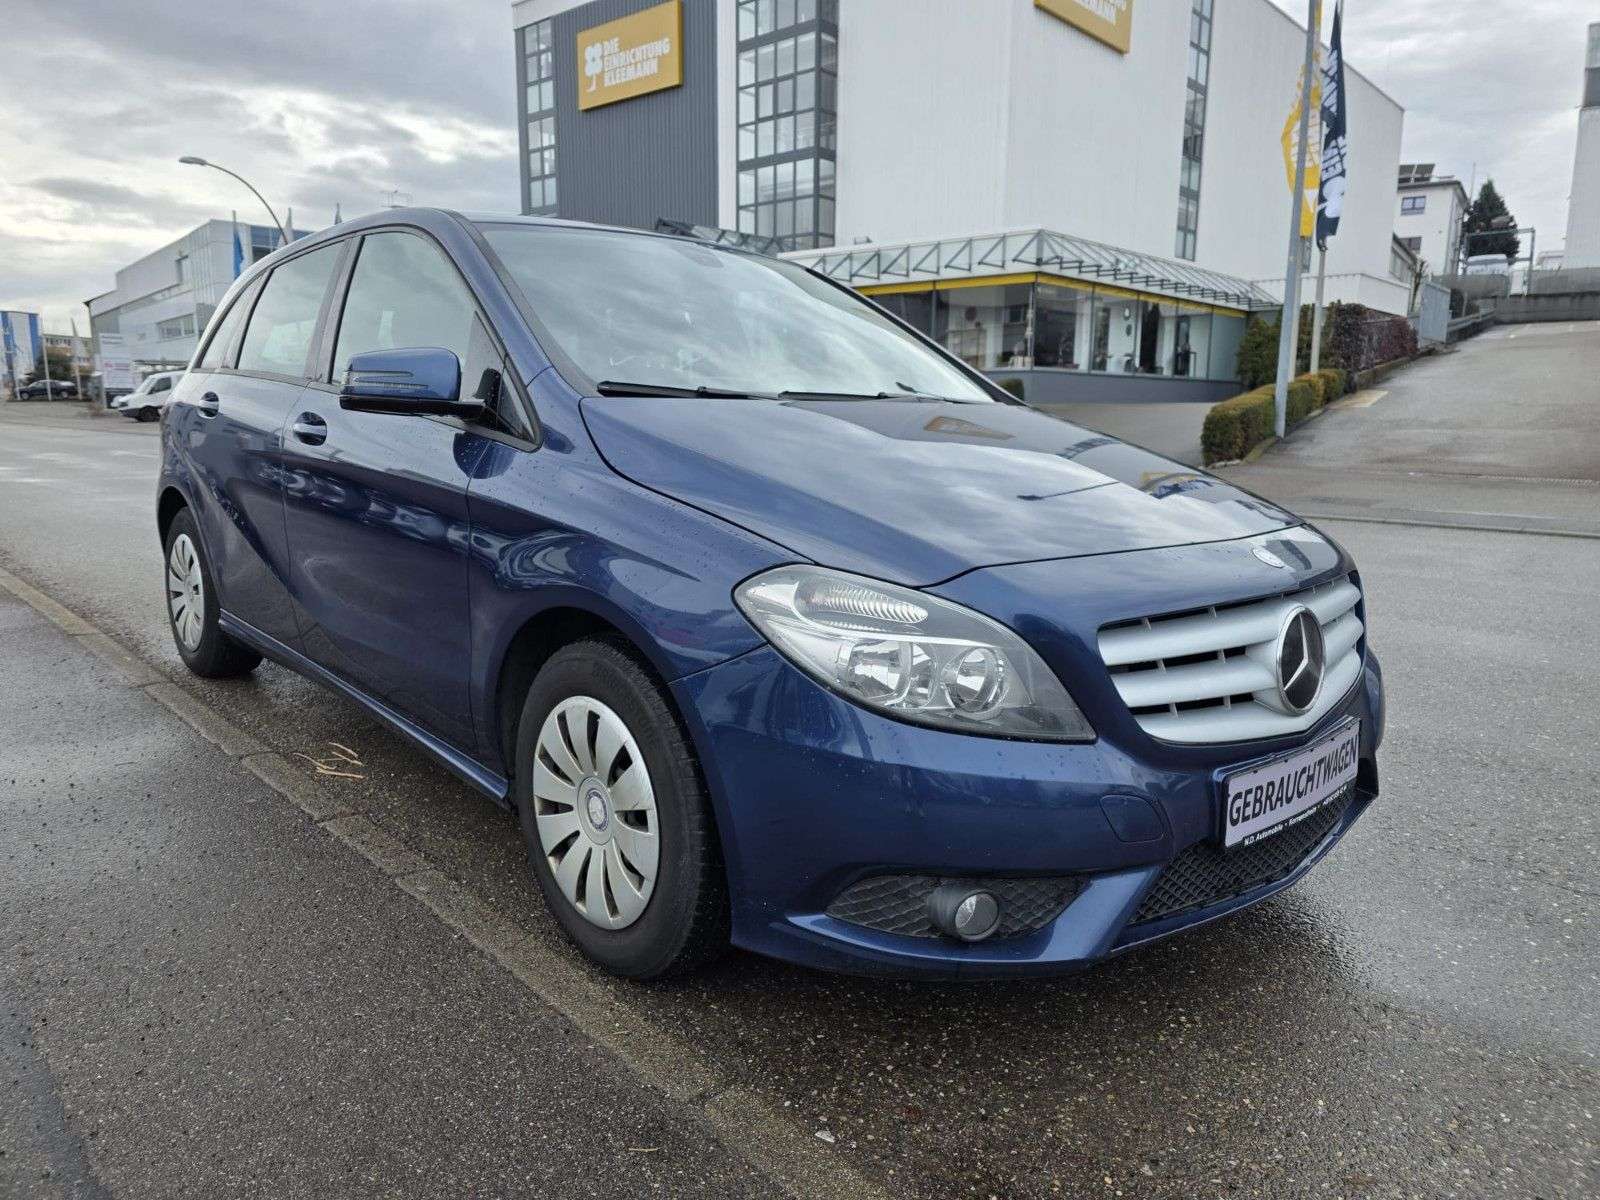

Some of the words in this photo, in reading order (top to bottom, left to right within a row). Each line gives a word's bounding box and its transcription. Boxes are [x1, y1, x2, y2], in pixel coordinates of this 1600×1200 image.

[603, 37, 619, 56] DIE
[603, 58, 659, 87] KLEEMANN
[1229, 734, 1358, 827] GEBRAUCHTWAGEN
